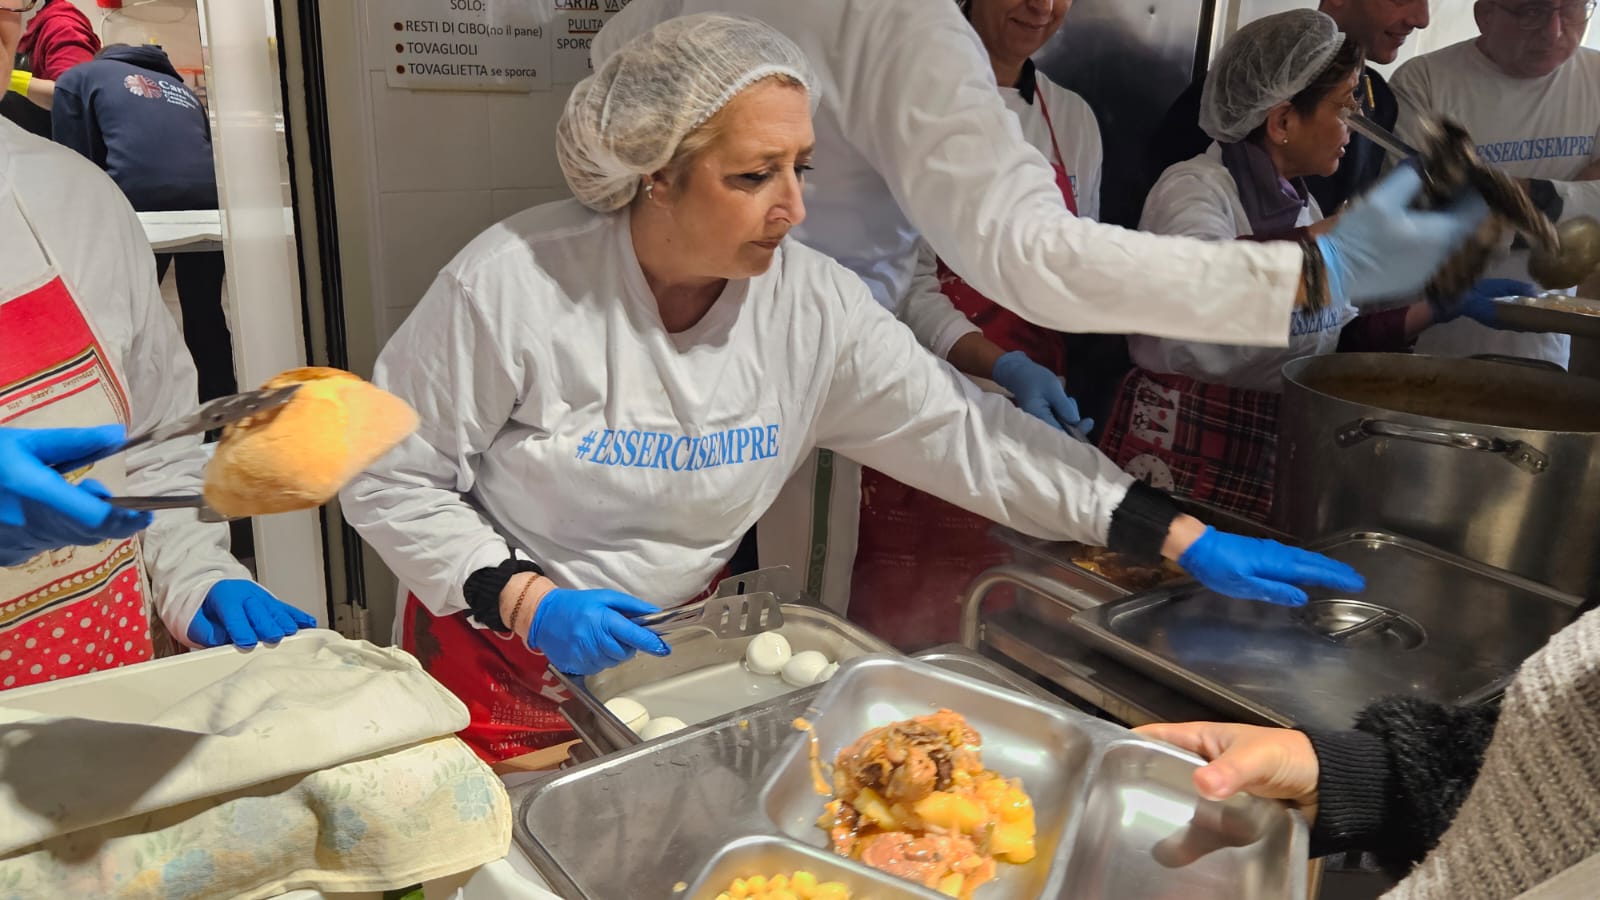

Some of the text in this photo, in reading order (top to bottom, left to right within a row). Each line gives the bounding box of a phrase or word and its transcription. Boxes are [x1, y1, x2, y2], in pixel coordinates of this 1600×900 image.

[450, 0, 486, 12] SOLO:
[555, 0, 599, 9] CARTA
[406, 20, 543, 39] RESTI DI CIBO(no il pane)
[567, 18, 604, 31] PULITA
[407, 41, 478, 56] TOVAGLIOLI
[556, 38, 593, 50] SPORC
[408, 62, 537, 80] TOVAGLIETTA se sporca
[1475, 135, 1594, 163] ESSERCISEMPRE
[574, 423, 780, 472] #ESSERCISEMPRE
